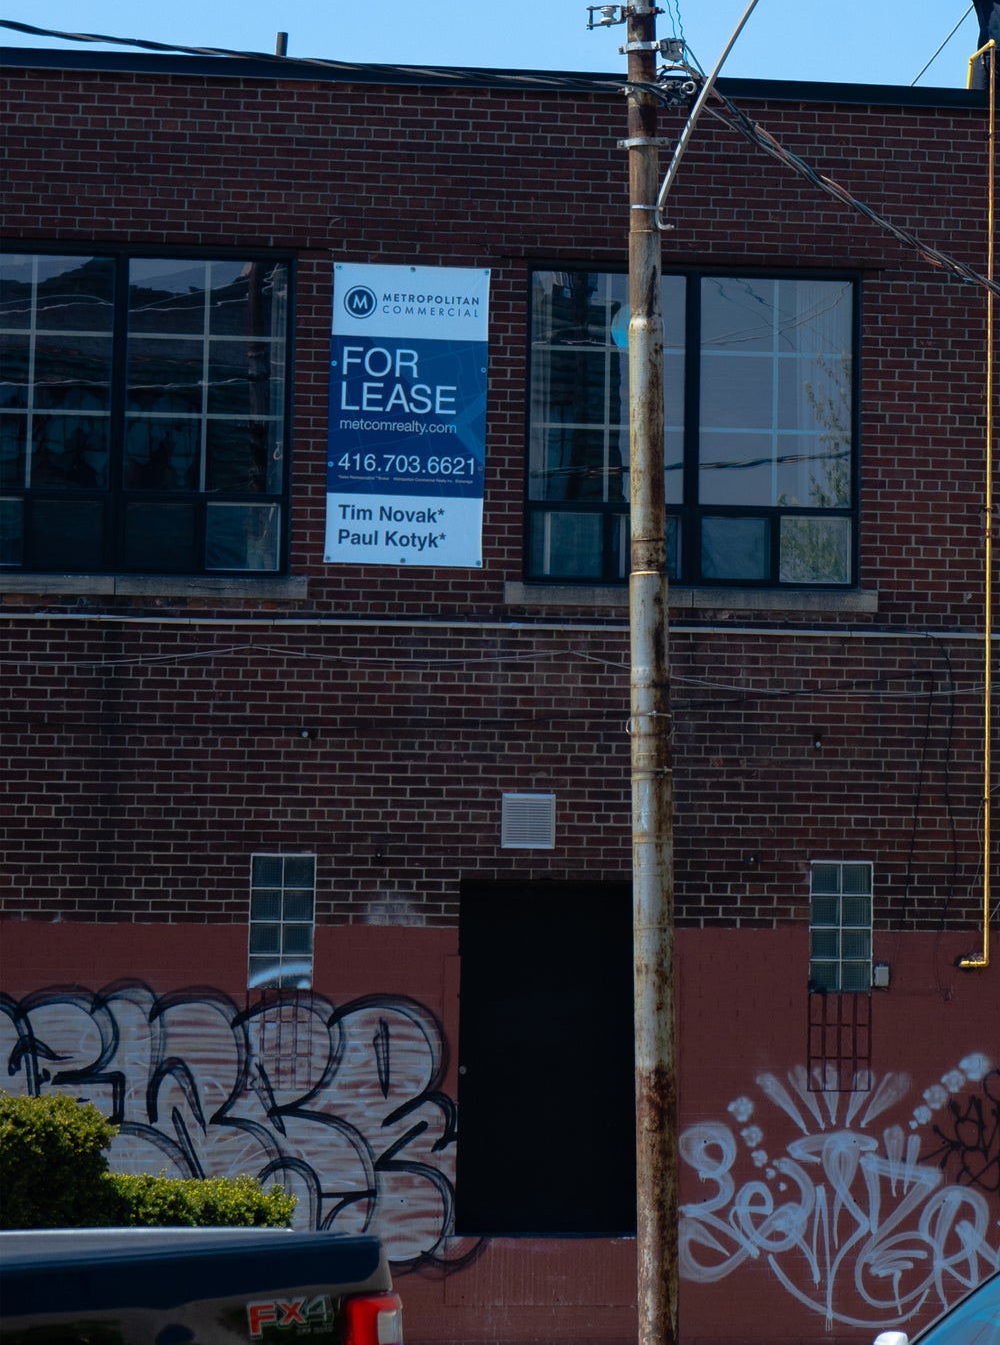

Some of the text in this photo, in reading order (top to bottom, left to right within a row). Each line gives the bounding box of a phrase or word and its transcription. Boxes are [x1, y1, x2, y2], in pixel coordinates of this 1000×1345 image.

[382, 293, 479, 306] METROPOLITAN
[382, 305, 479, 318] COMMERCIAL
[342, 346, 419, 378] FOR
[340, 381, 457, 415] LEASE
[339, 418, 457, 436] metcomrealty.com
[337, 452, 475, 475] 416.703.6621
[338, 504, 373, 521] Tim
[338, 528, 379, 546] Paul
[246, 1294, 334, 1340] FX4
